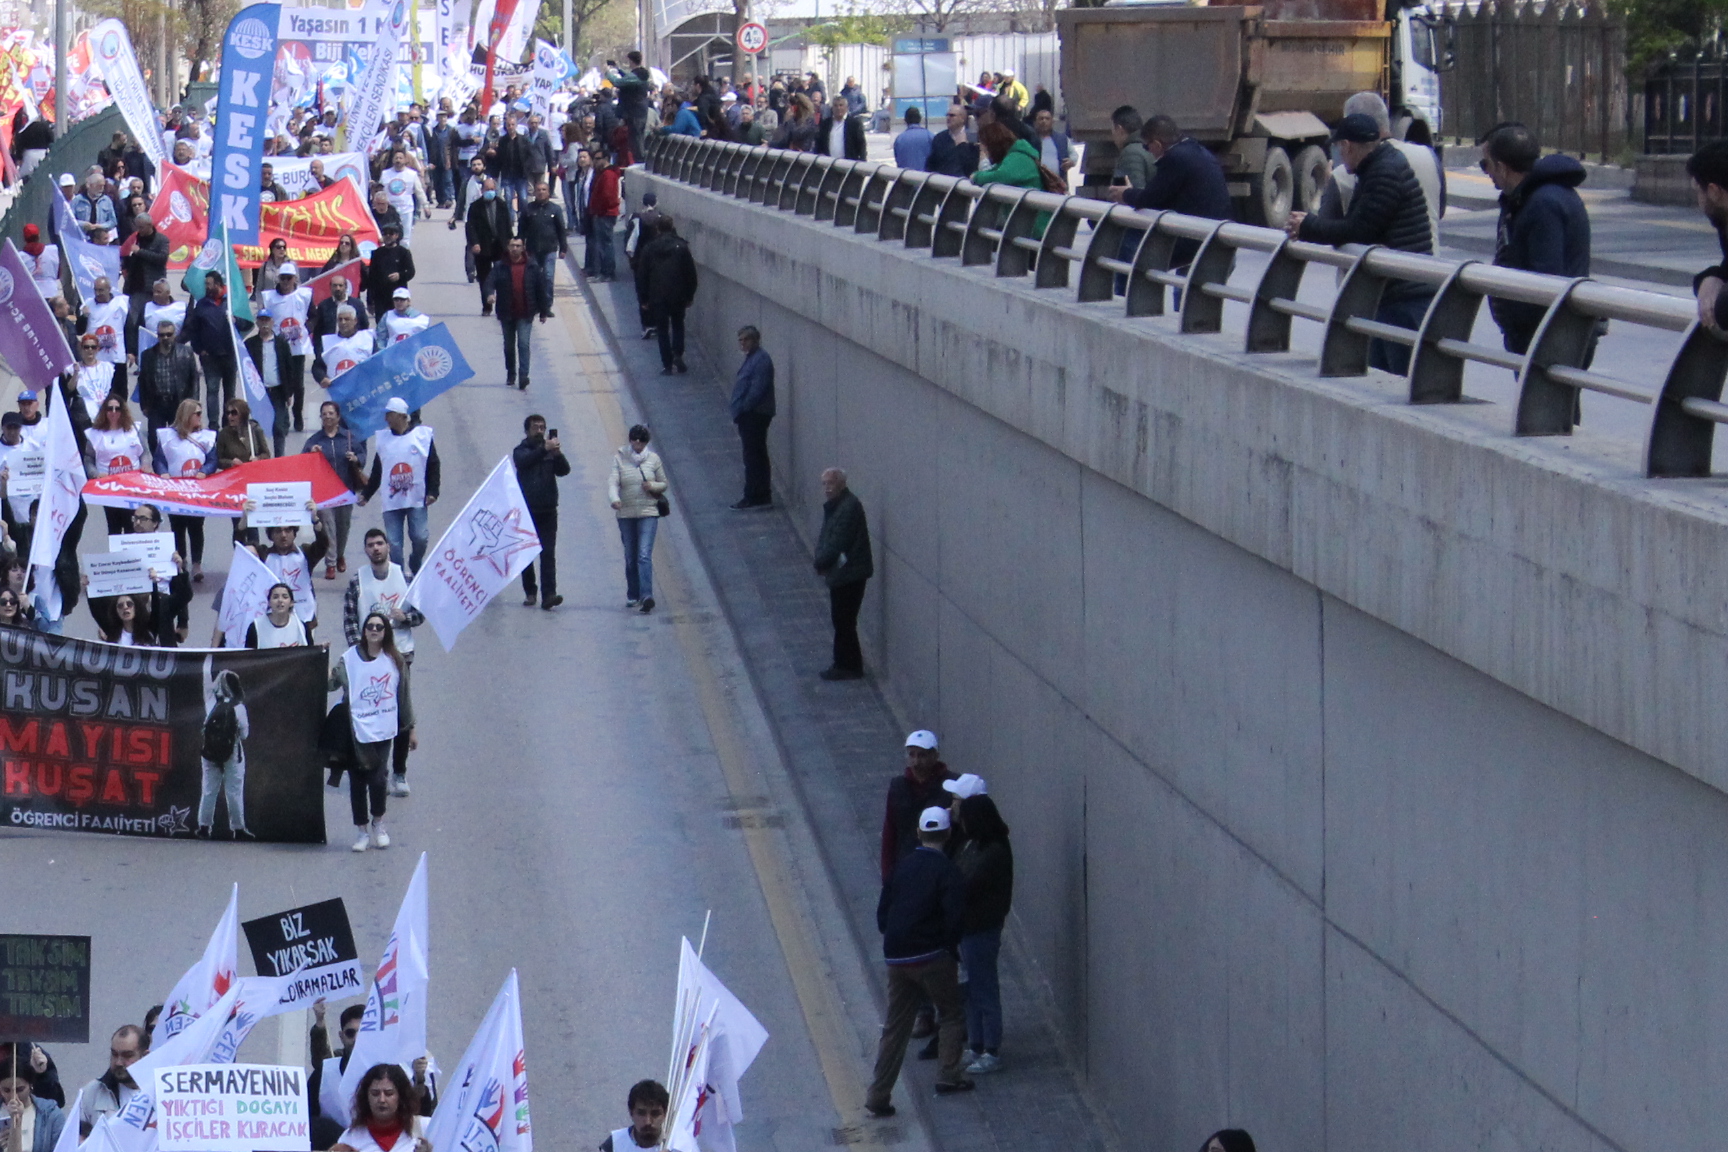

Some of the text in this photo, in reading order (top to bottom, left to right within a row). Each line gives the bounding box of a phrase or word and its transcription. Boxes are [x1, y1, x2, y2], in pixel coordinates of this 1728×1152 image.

[290, 14, 349, 36] Yaşasın
[744, 31, 751, 44] 4
[229, 31, 273, 51] KESK
[221, 69, 262, 231] KESK
[434, 561, 479, 617] FAALİYETİ
[444, 547, 488, 605] ÖĞRENCİ
[10, 806, 157, 835] ÖĞRENCİ FAALİYETİ
[280, 912, 311, 942] BİZ
[266, 936, 339, 977] YIKARSAK
[279, 967, 361, 1005] DIRAMAZLAR
[160, 1067, 301, 1096] SERMAYENİN
[166, 1118, 307, 1142] İŞÇİLER KURACAK
